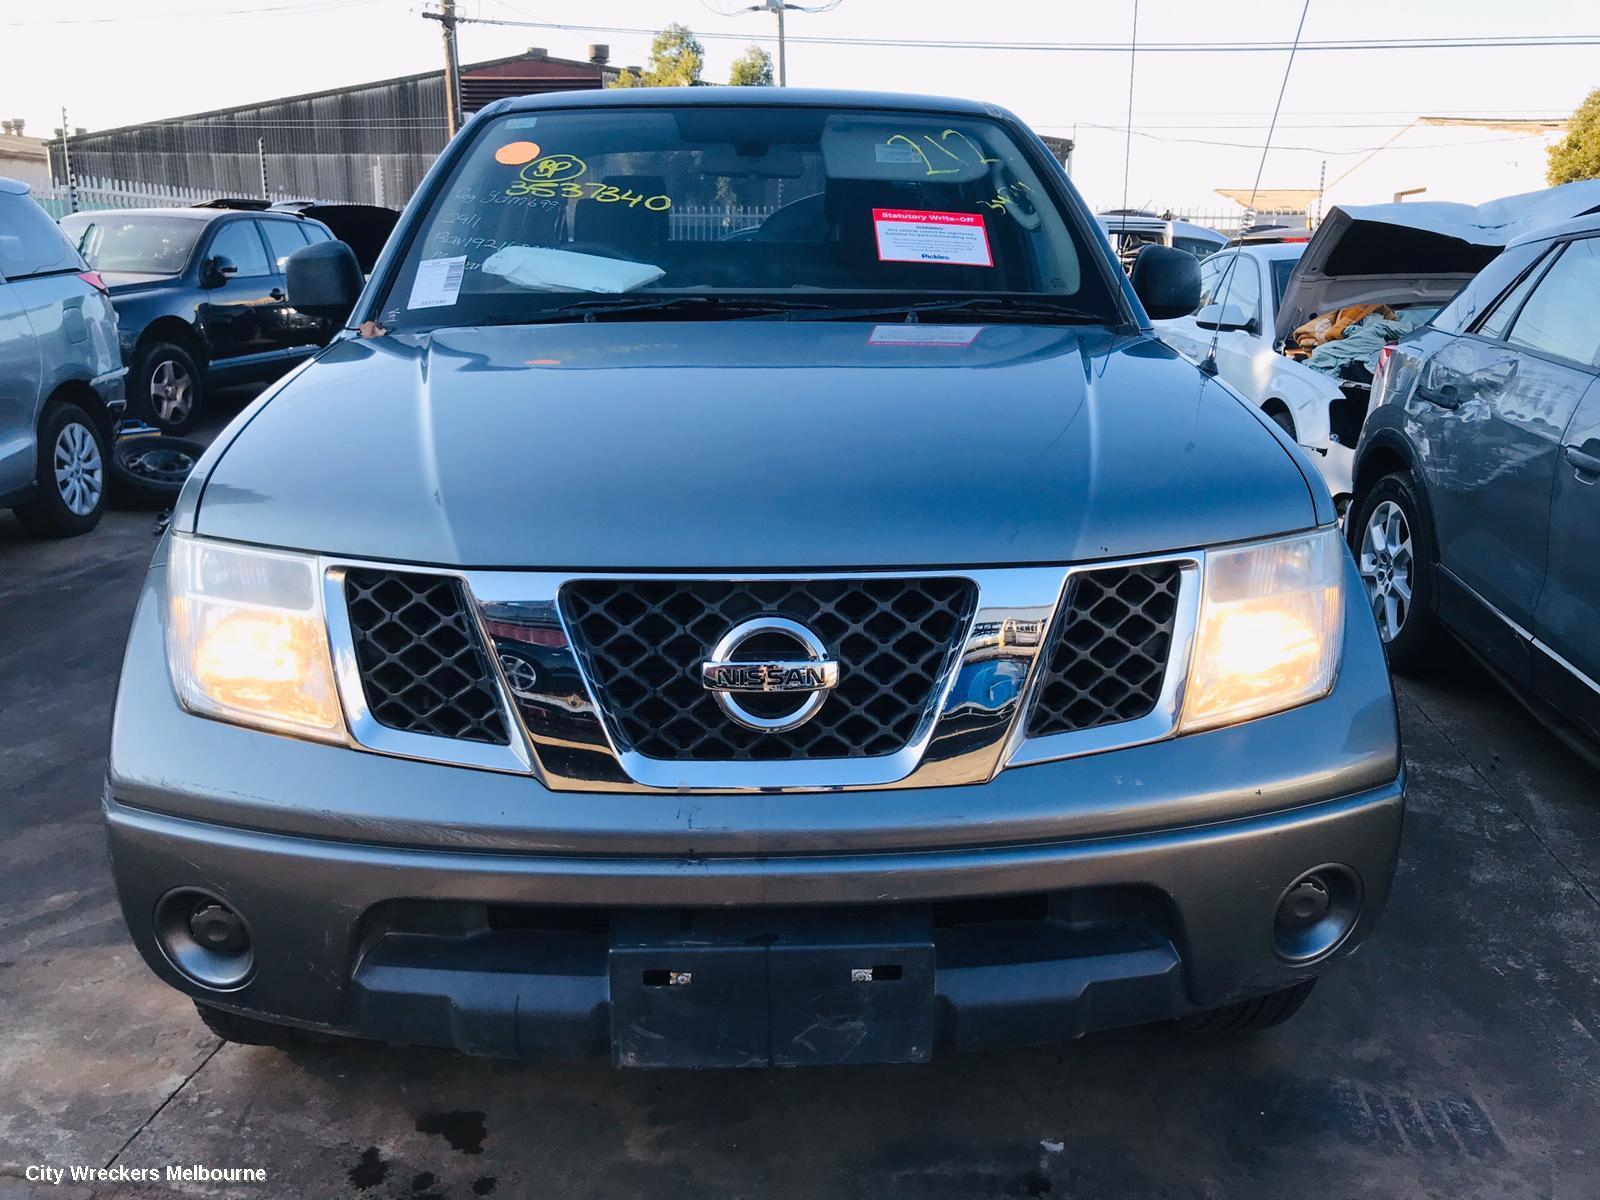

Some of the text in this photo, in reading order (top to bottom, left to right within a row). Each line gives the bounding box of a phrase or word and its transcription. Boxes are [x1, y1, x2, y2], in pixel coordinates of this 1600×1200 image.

[881, 211, 975, 223] Statutory Write-Off
[716, 667, 825, 687] NISSAN
